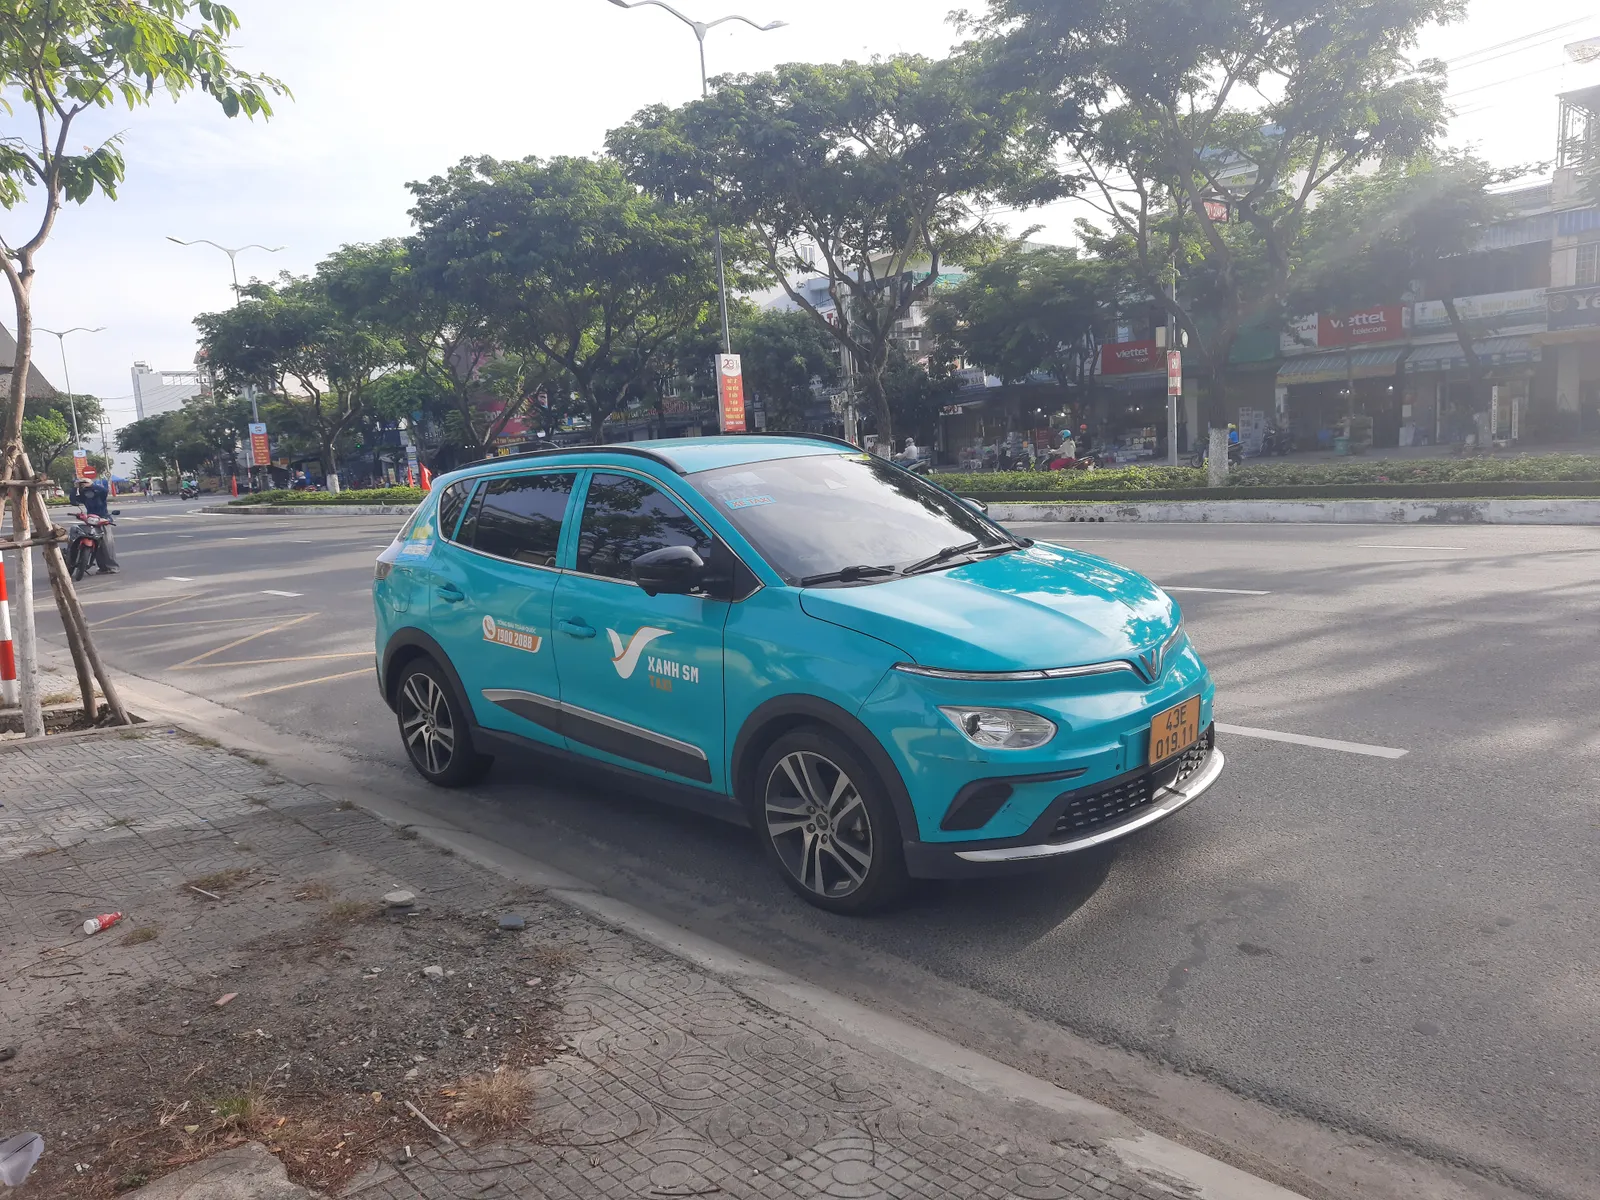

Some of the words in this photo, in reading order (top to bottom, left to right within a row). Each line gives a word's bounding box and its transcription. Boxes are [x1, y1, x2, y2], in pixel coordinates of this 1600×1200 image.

[1352, 326, 1387, 336] telecom
[1115, 347, 1149, 358] viettel
[747, 496, 773, 505] TAXI
[497, 628, 514, 645] 1900
[513, 632, 533, 650] 2088
[647, 655, 680, 679] XANH
[681, 664, 699, 684] SM
[648, 674, 673, 693] TAXI
[1166, 704, 1187, 731] 43E
[1156, 723, 1193, 760] 019.11
